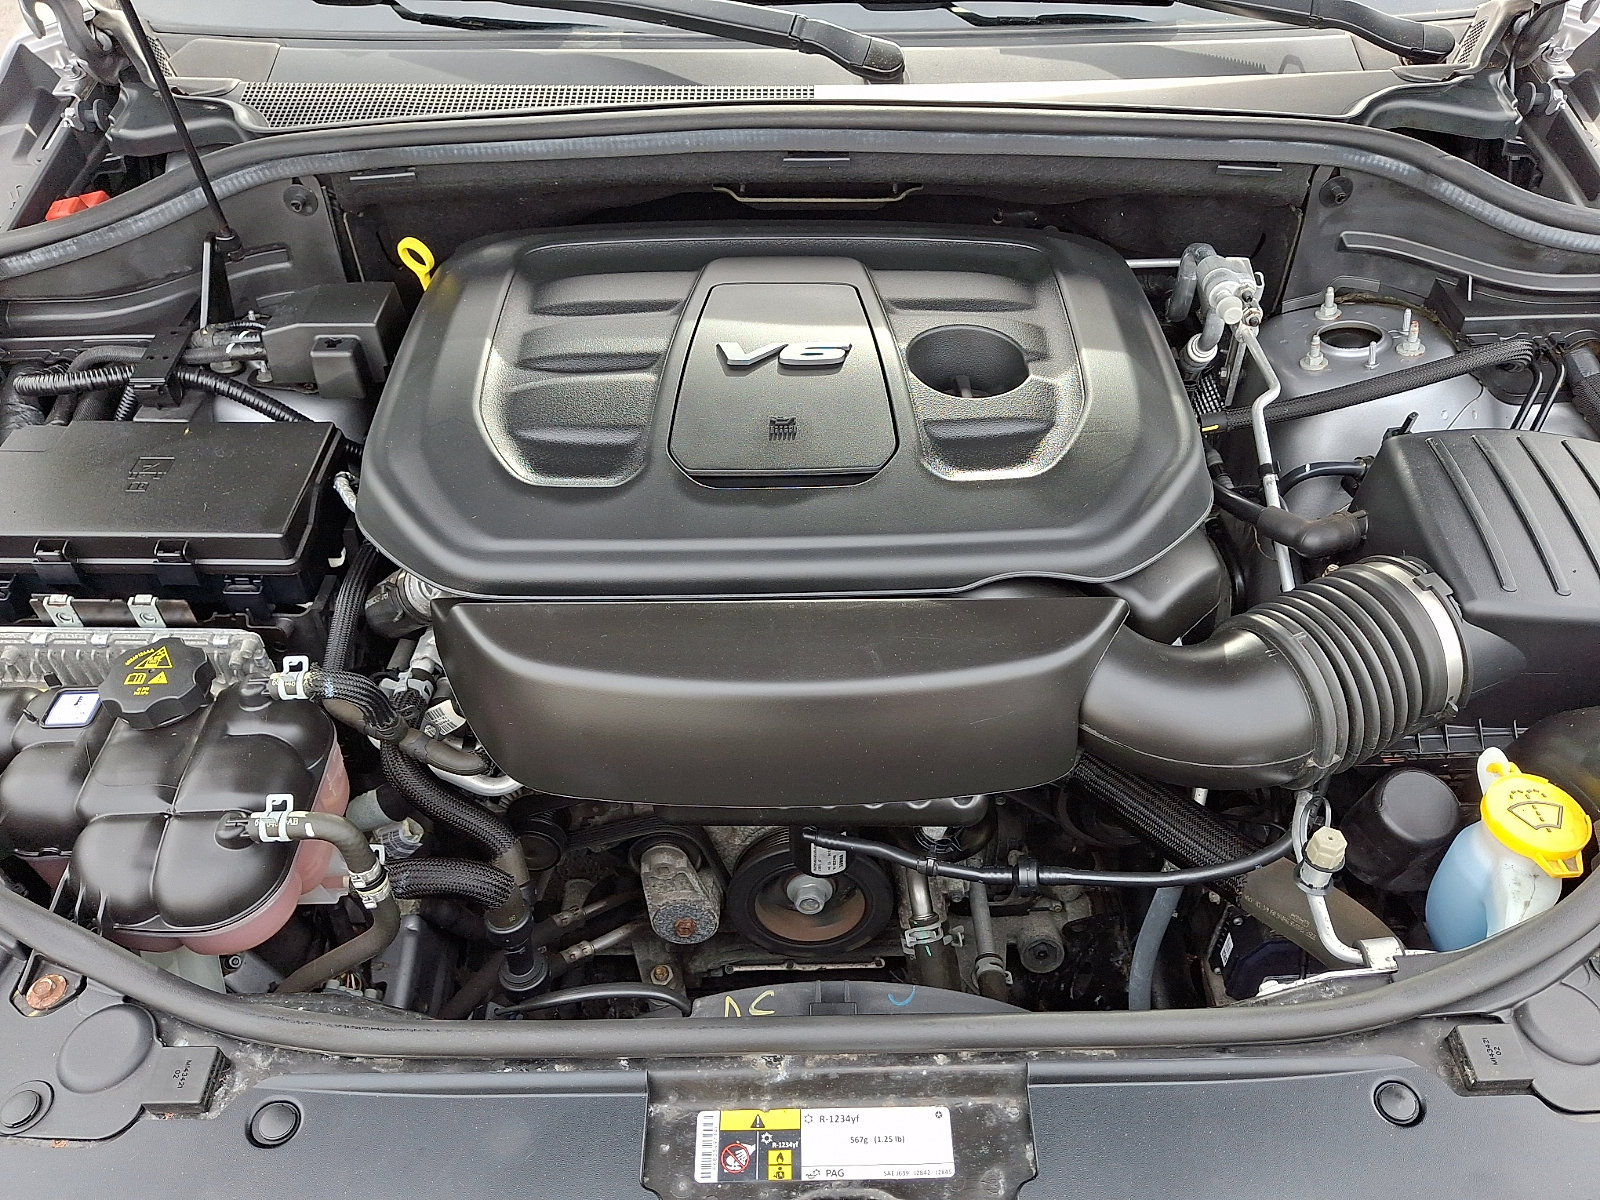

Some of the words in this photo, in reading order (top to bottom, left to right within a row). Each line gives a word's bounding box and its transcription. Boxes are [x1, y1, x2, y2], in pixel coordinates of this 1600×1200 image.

[715, 341, 853, 367] V6
[819, 1113, 860, 1124] R-1234yf
[771, 1140, 799, 1149] R-1234yf
[849, 1135, 869, 1145] 567g
[873, 1135, 893, 1144] (1.25
[825, 1168, 845, 1178] PAG
